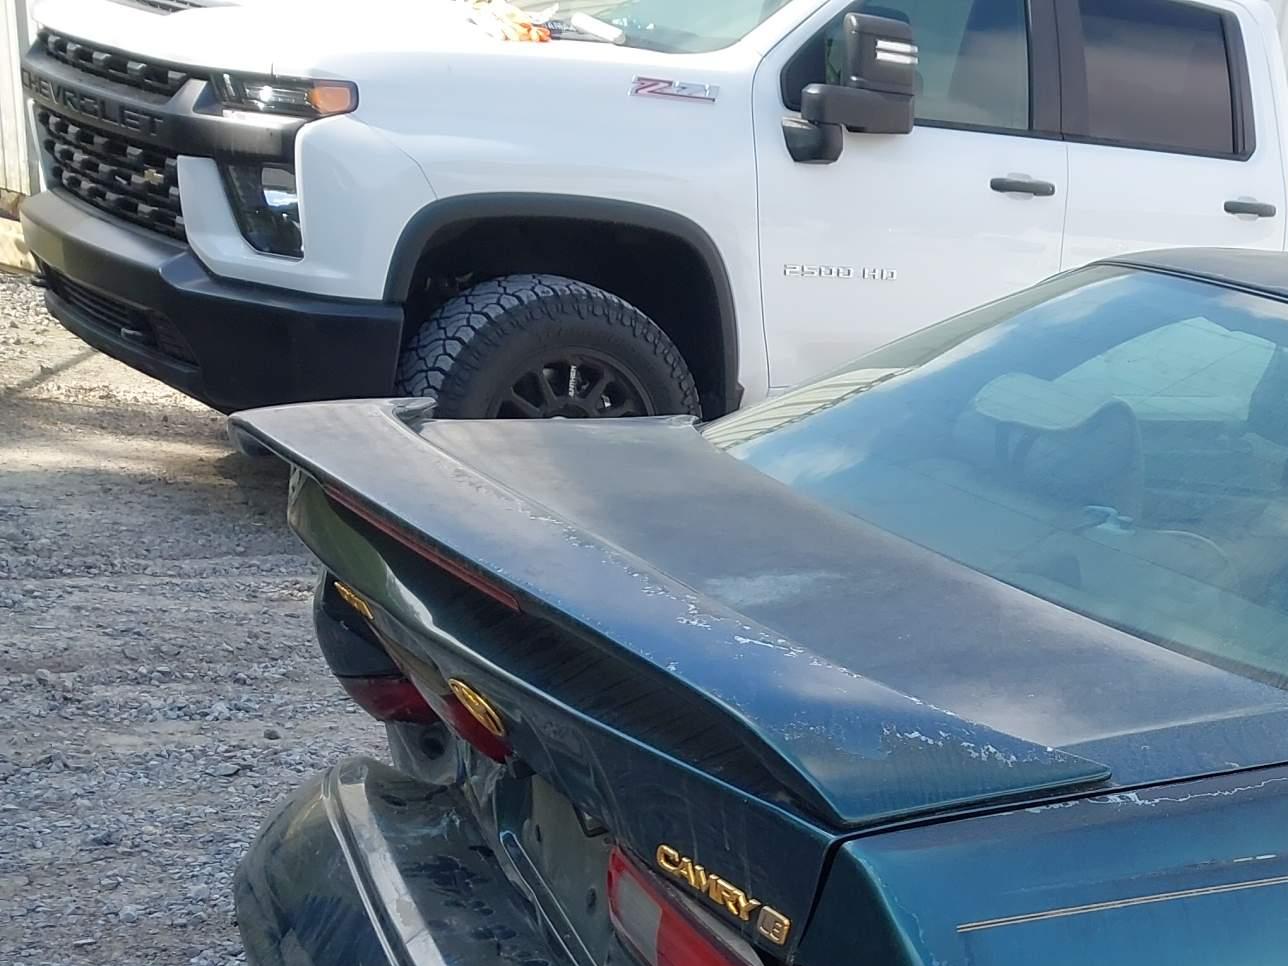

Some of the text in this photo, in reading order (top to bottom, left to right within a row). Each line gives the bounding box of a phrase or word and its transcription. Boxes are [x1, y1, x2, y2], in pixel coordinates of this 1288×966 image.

[783, 264, 897, 280] 2500 HD
[657, 844, 762, 921] CAMRY
